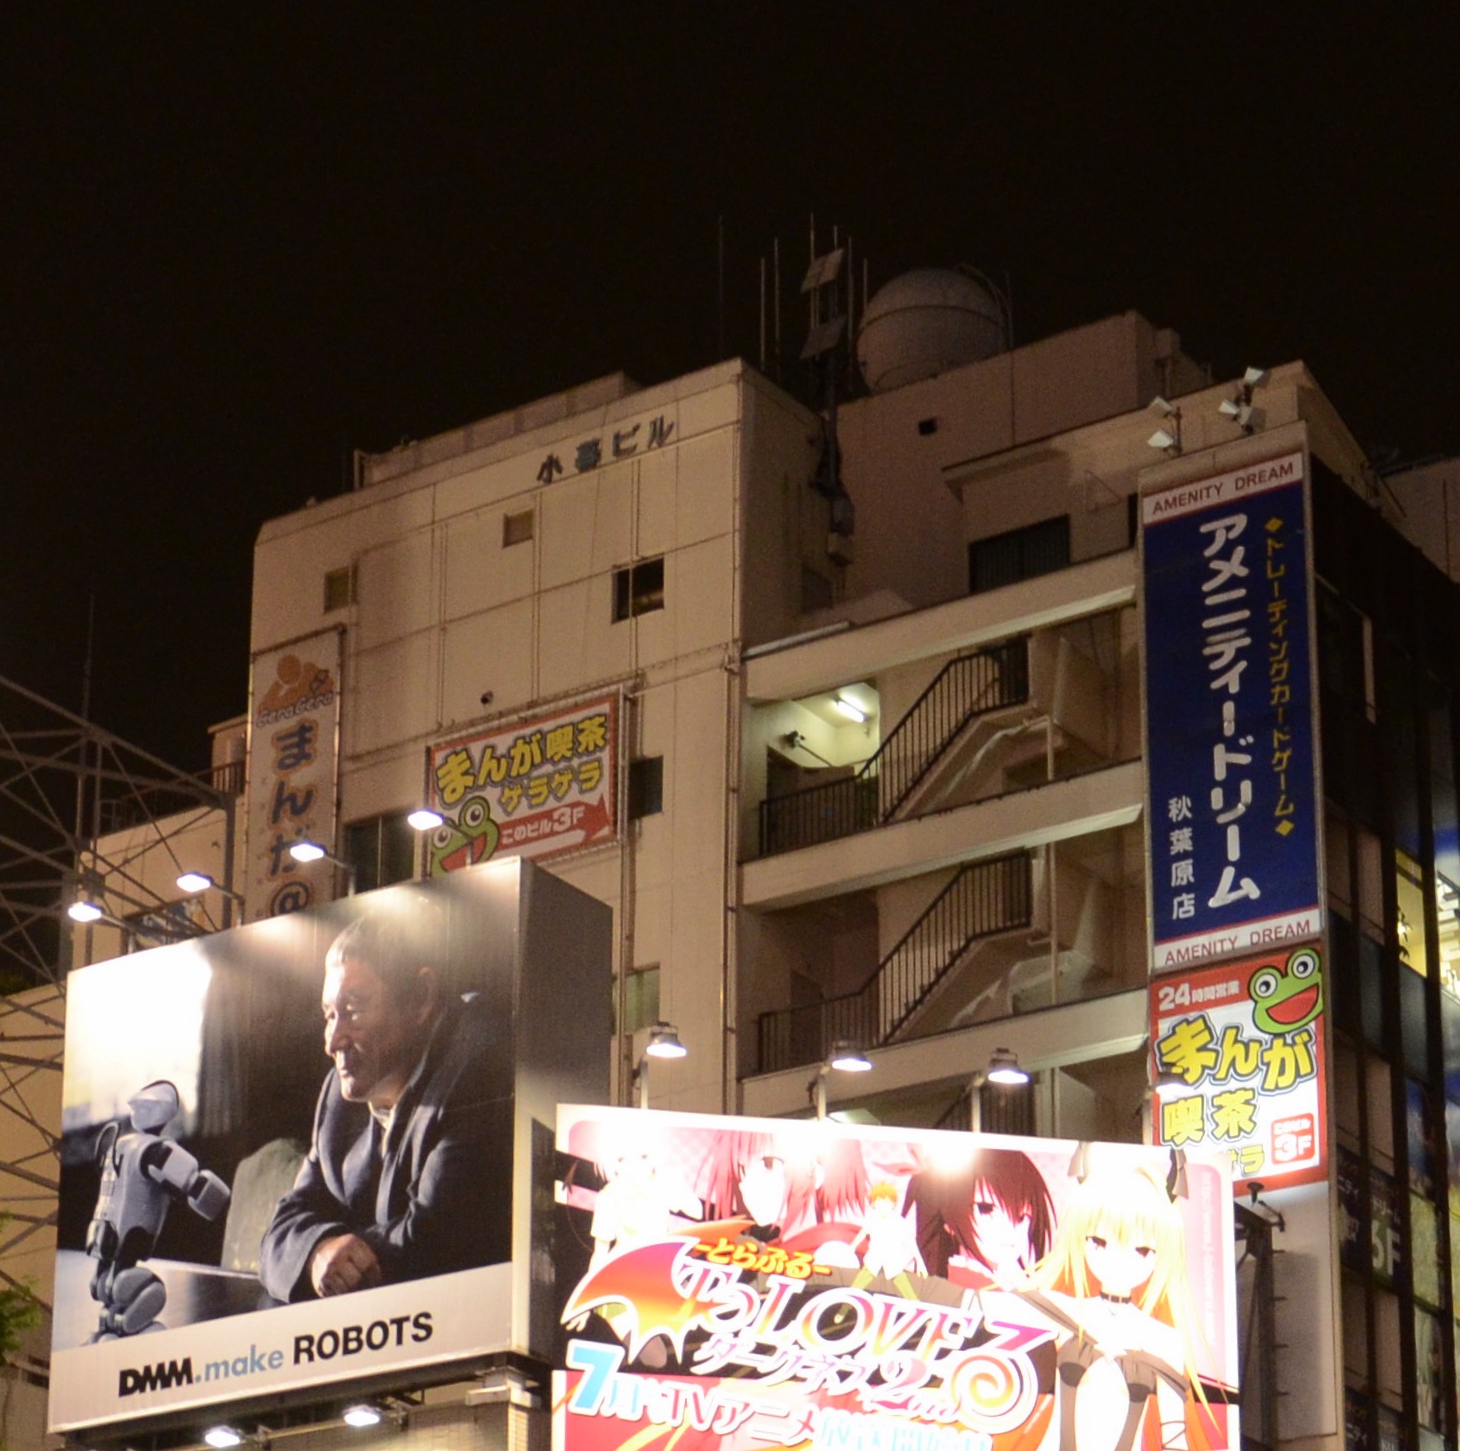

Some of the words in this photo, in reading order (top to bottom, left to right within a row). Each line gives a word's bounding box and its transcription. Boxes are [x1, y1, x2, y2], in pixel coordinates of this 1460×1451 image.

[1152, 481, 1224, 516] AMENITY
[1234, 461, 1295, 491] DREAM
[1199, 513, 1262, 909] アメニティードリーム
[1265, 536, 1296, 820] トレーディングカードゲーム
[436, 712, 609, 804] まんが喫茶
[500, 756, 603, 812] ゲラゲラ
[1167, 794, 1197, 922] 秋葉原店
[1164, 935, 1239, 965] AMENITY
[1249, 918, 1311, 946] DREAM
[1158, 1016, 1315, 1092] まんが
[1161, 1087, 1258, 1146] 喫茶
[117, 1343, 285, 1398] DMM.make
[293, 1311, 434, 1368] ROBOTS
